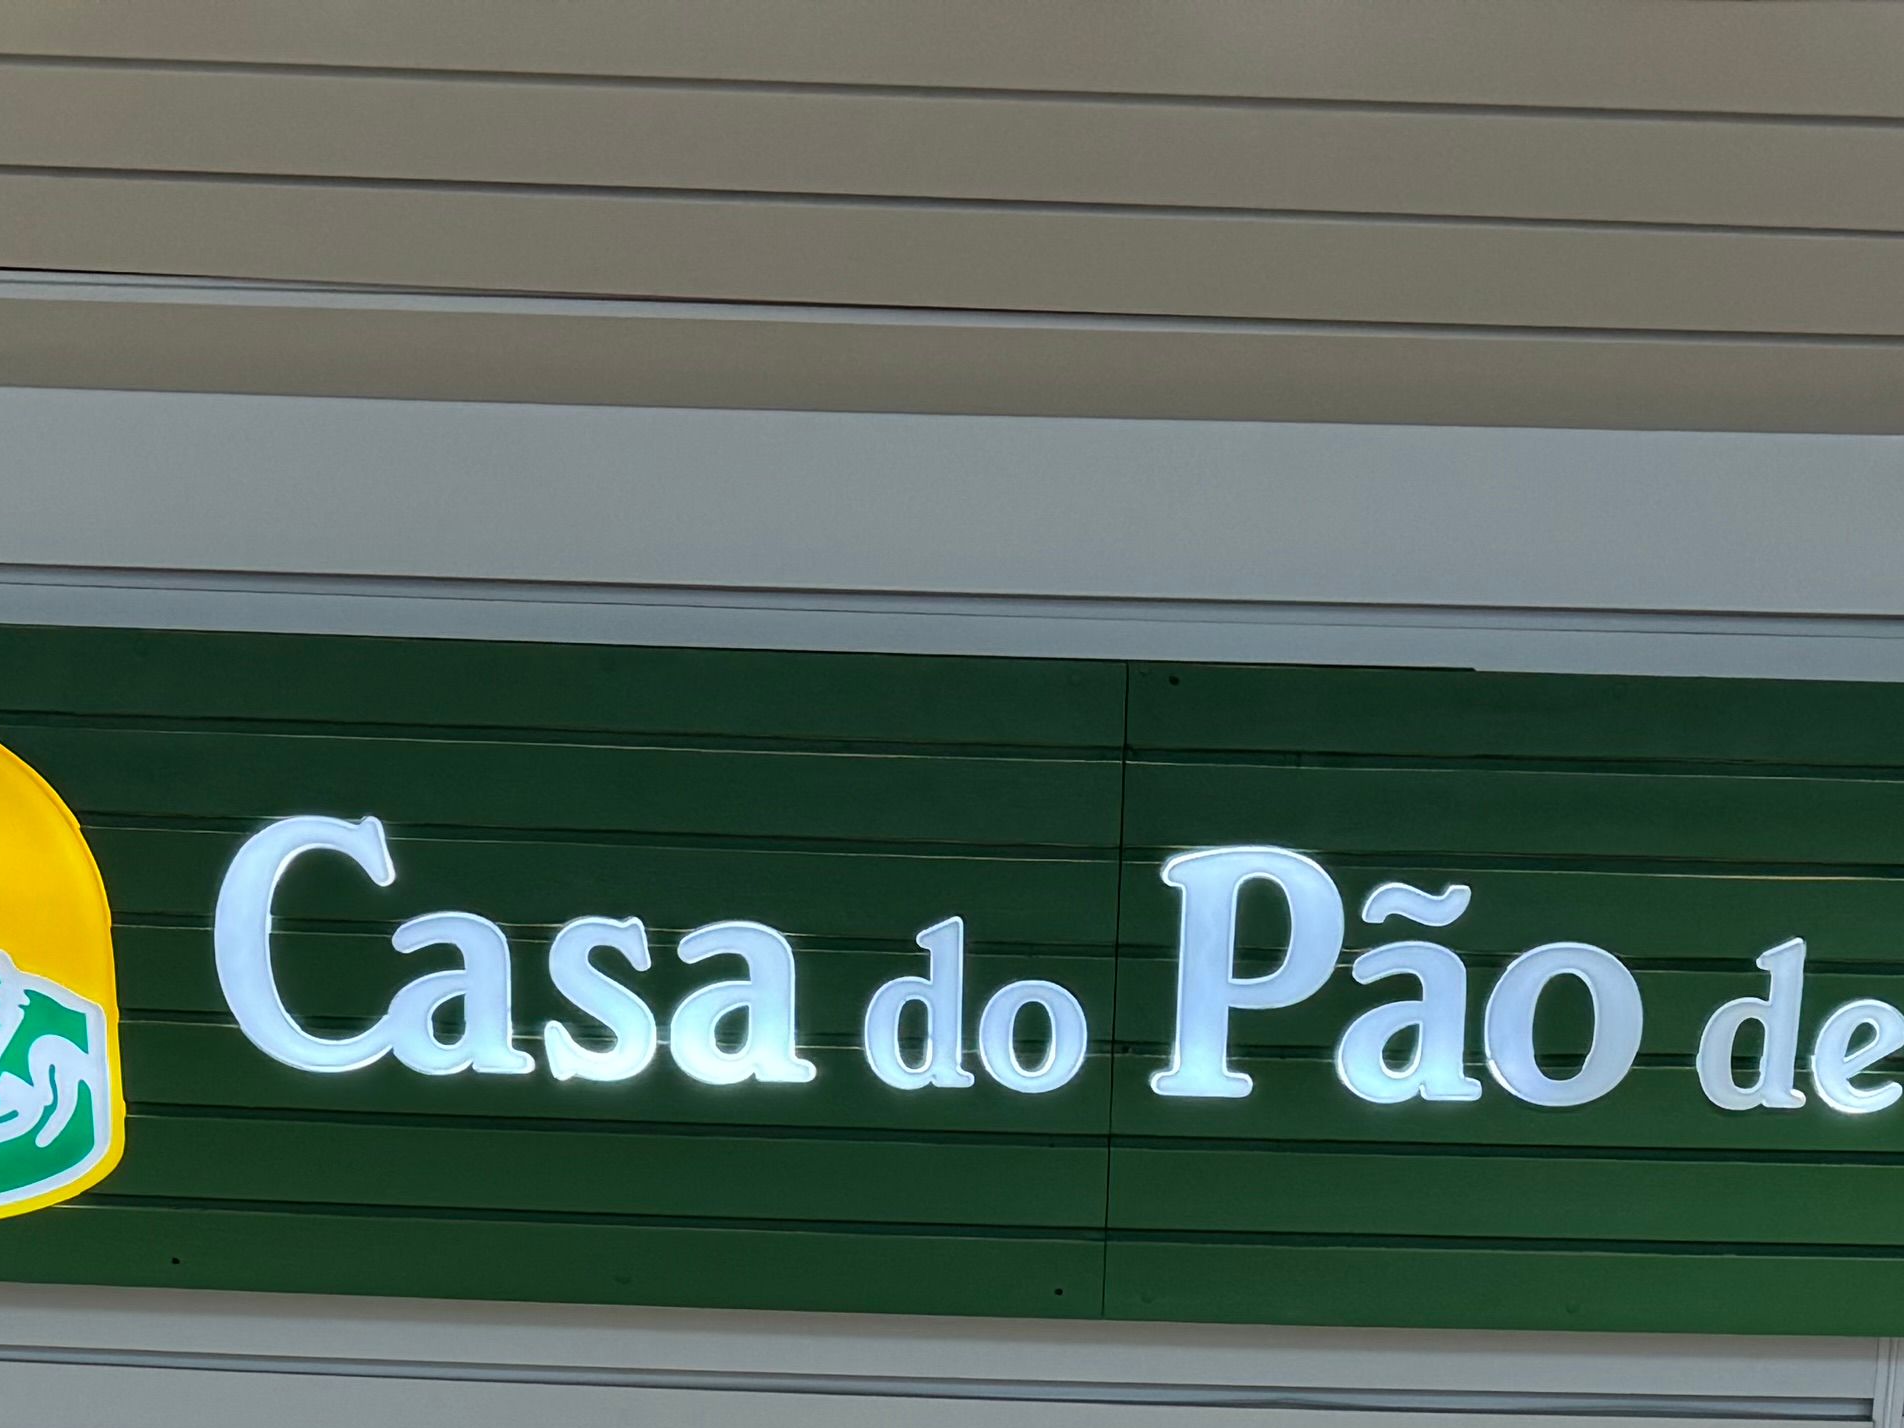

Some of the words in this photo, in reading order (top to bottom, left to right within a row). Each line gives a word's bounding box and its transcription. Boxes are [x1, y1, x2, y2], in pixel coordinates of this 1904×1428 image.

[211, 813, 818, 1086] Casa
[862, 915, 1088, 1094] do
[1148, 844, 1644, 1107] Pão
